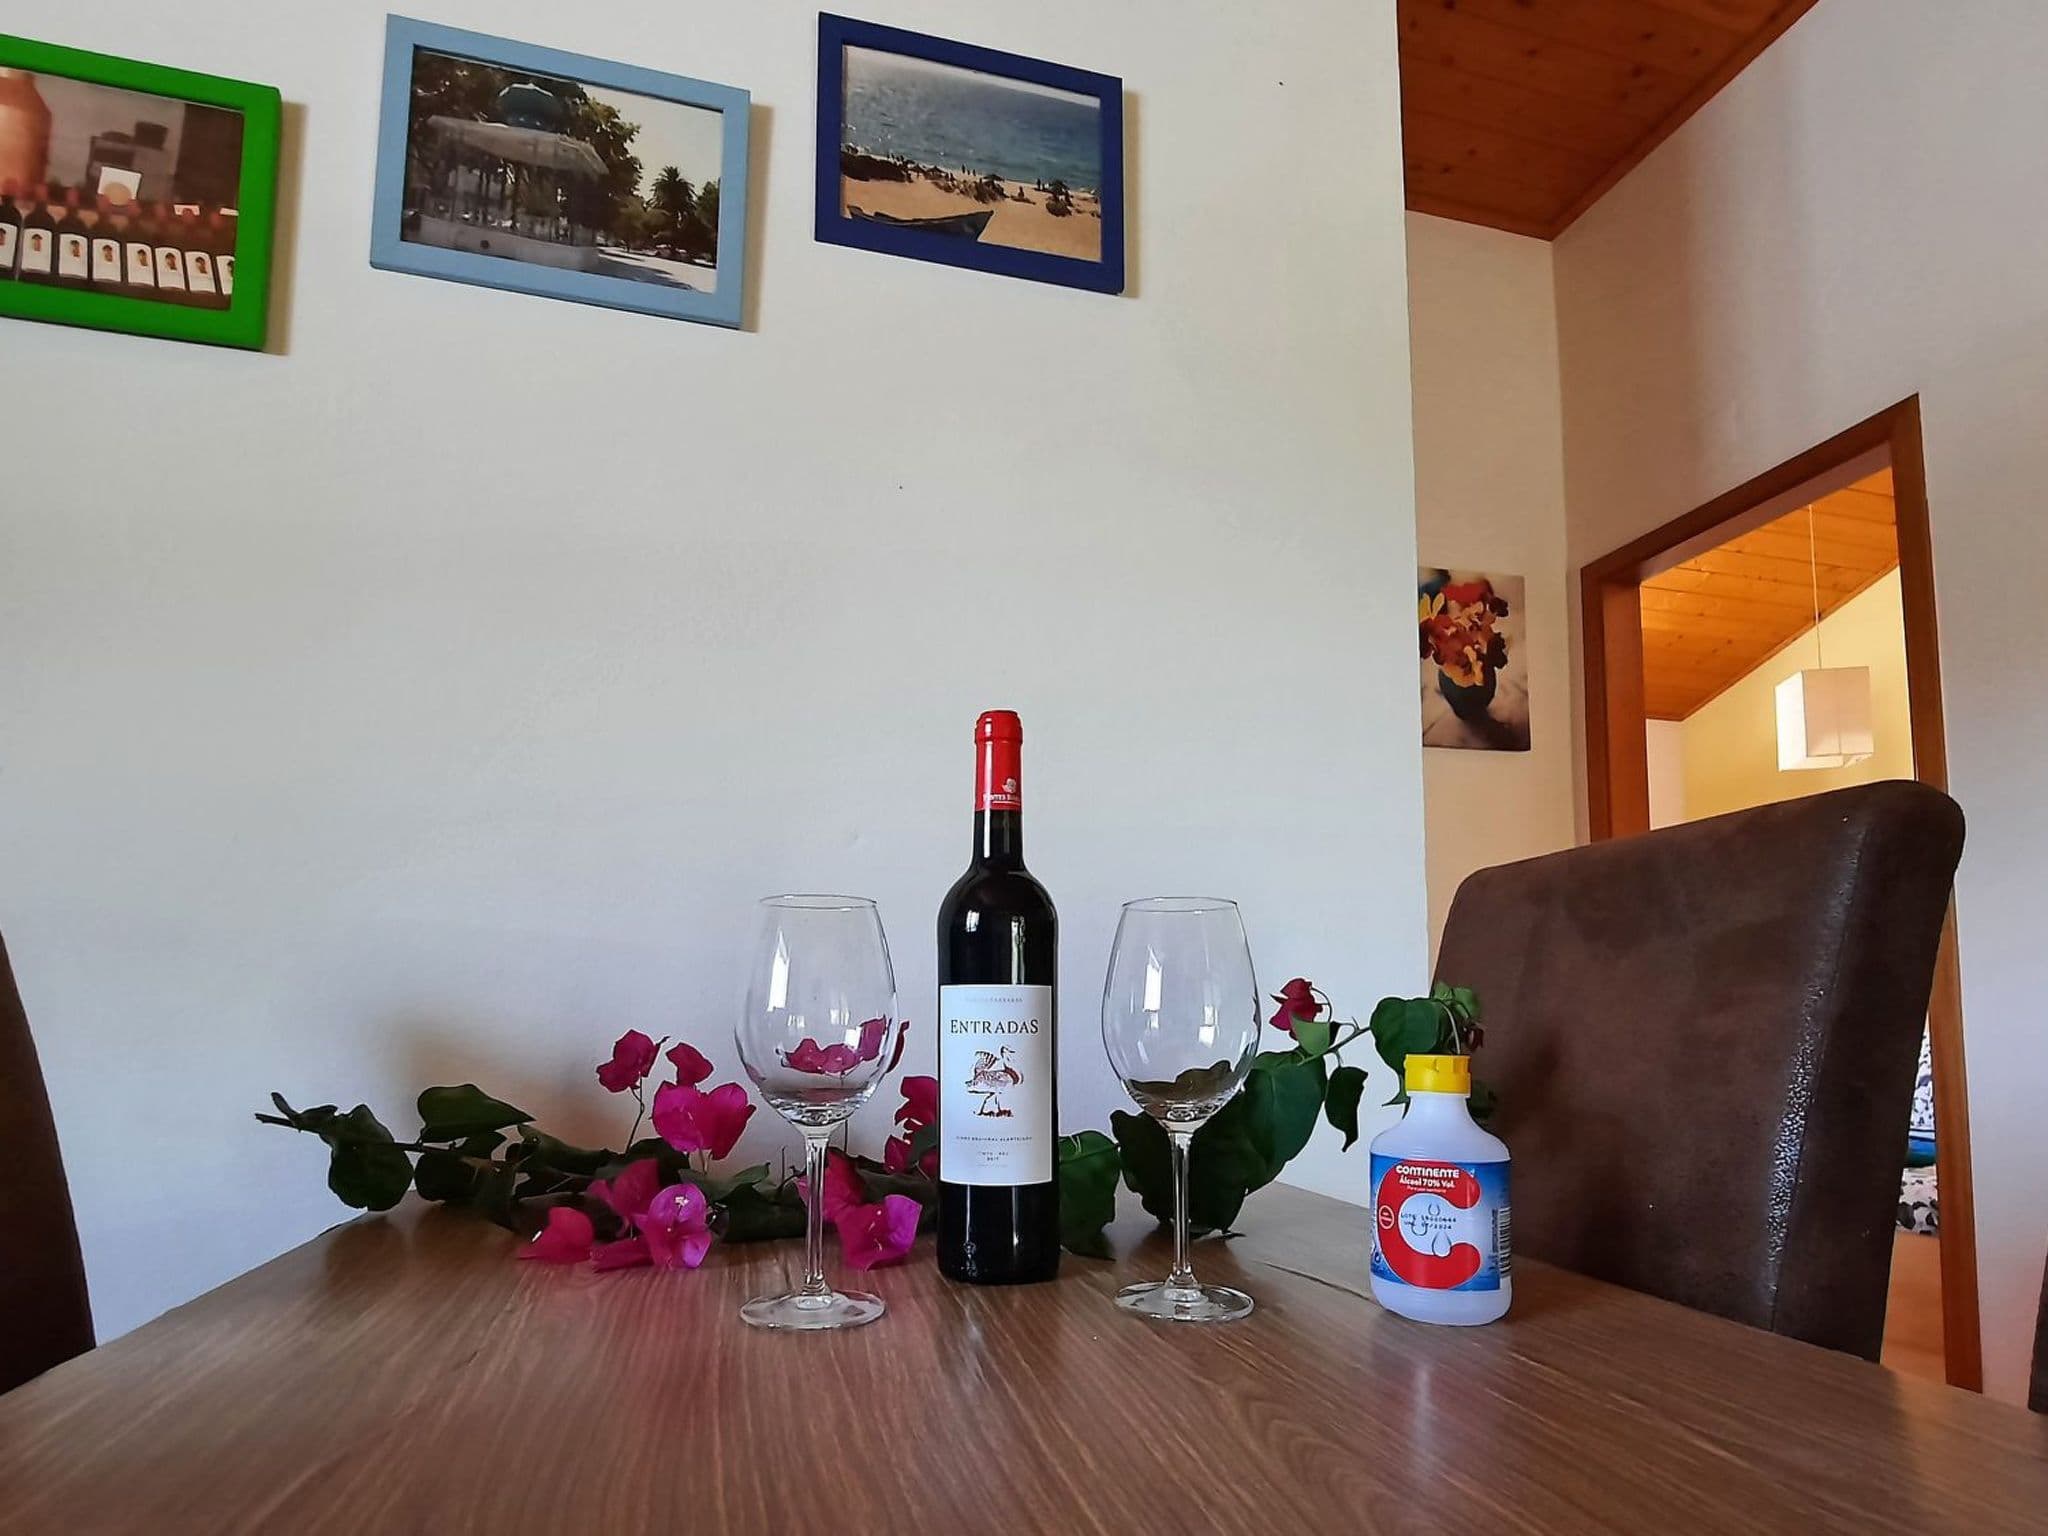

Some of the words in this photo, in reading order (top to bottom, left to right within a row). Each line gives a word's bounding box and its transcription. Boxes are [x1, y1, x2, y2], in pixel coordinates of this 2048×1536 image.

[950, 1019, 1039, 1034] ENTRADAS
[1395, 1165, 1460, 1179] CONTINENTE
[1422, 1178, 1441, 1188] 70%
